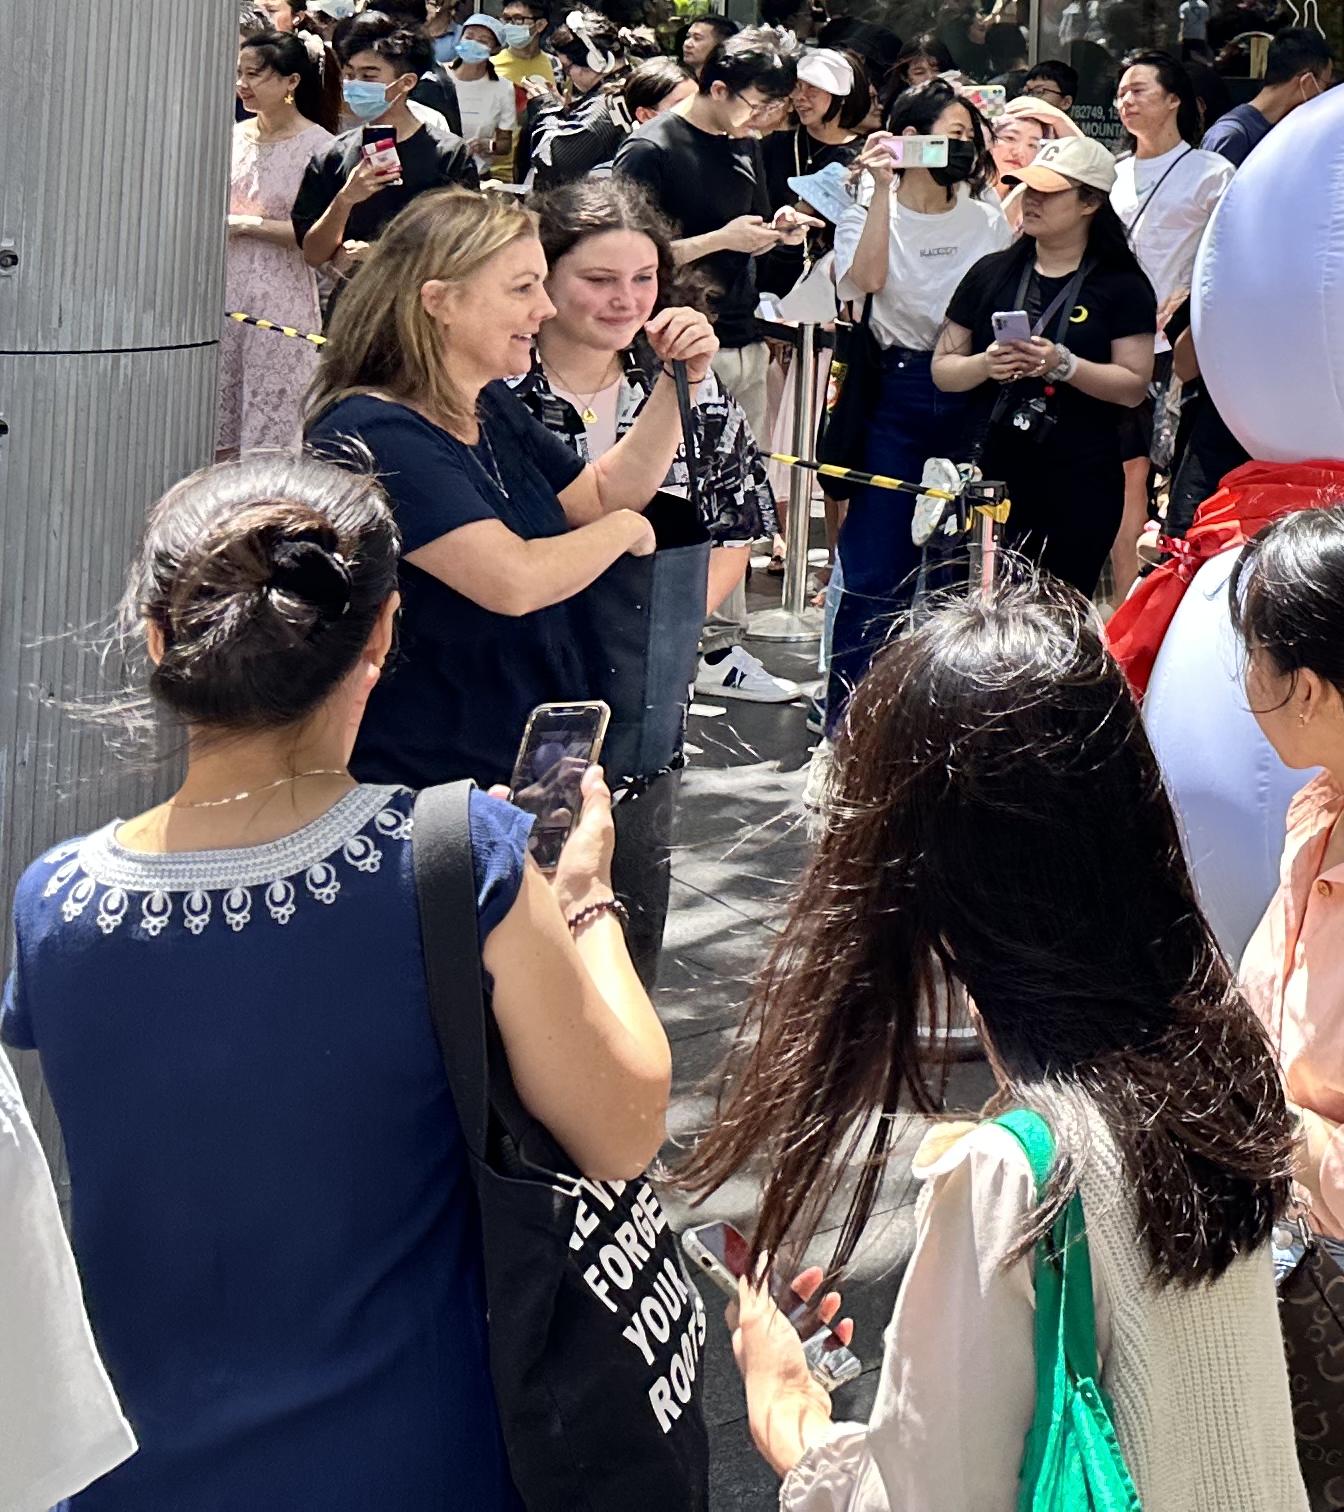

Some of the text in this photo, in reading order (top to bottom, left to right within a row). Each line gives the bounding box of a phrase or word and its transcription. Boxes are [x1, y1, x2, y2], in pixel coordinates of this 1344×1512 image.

[1042, 145, 1060, 162] C
[1081, 122, 1128, 137] MOUNTA
[582, 1183, 668, 1313] FORGE
[622, 1257, 692, 1367] YOUR
[648, 1303, 708, 1434] ROOTS
